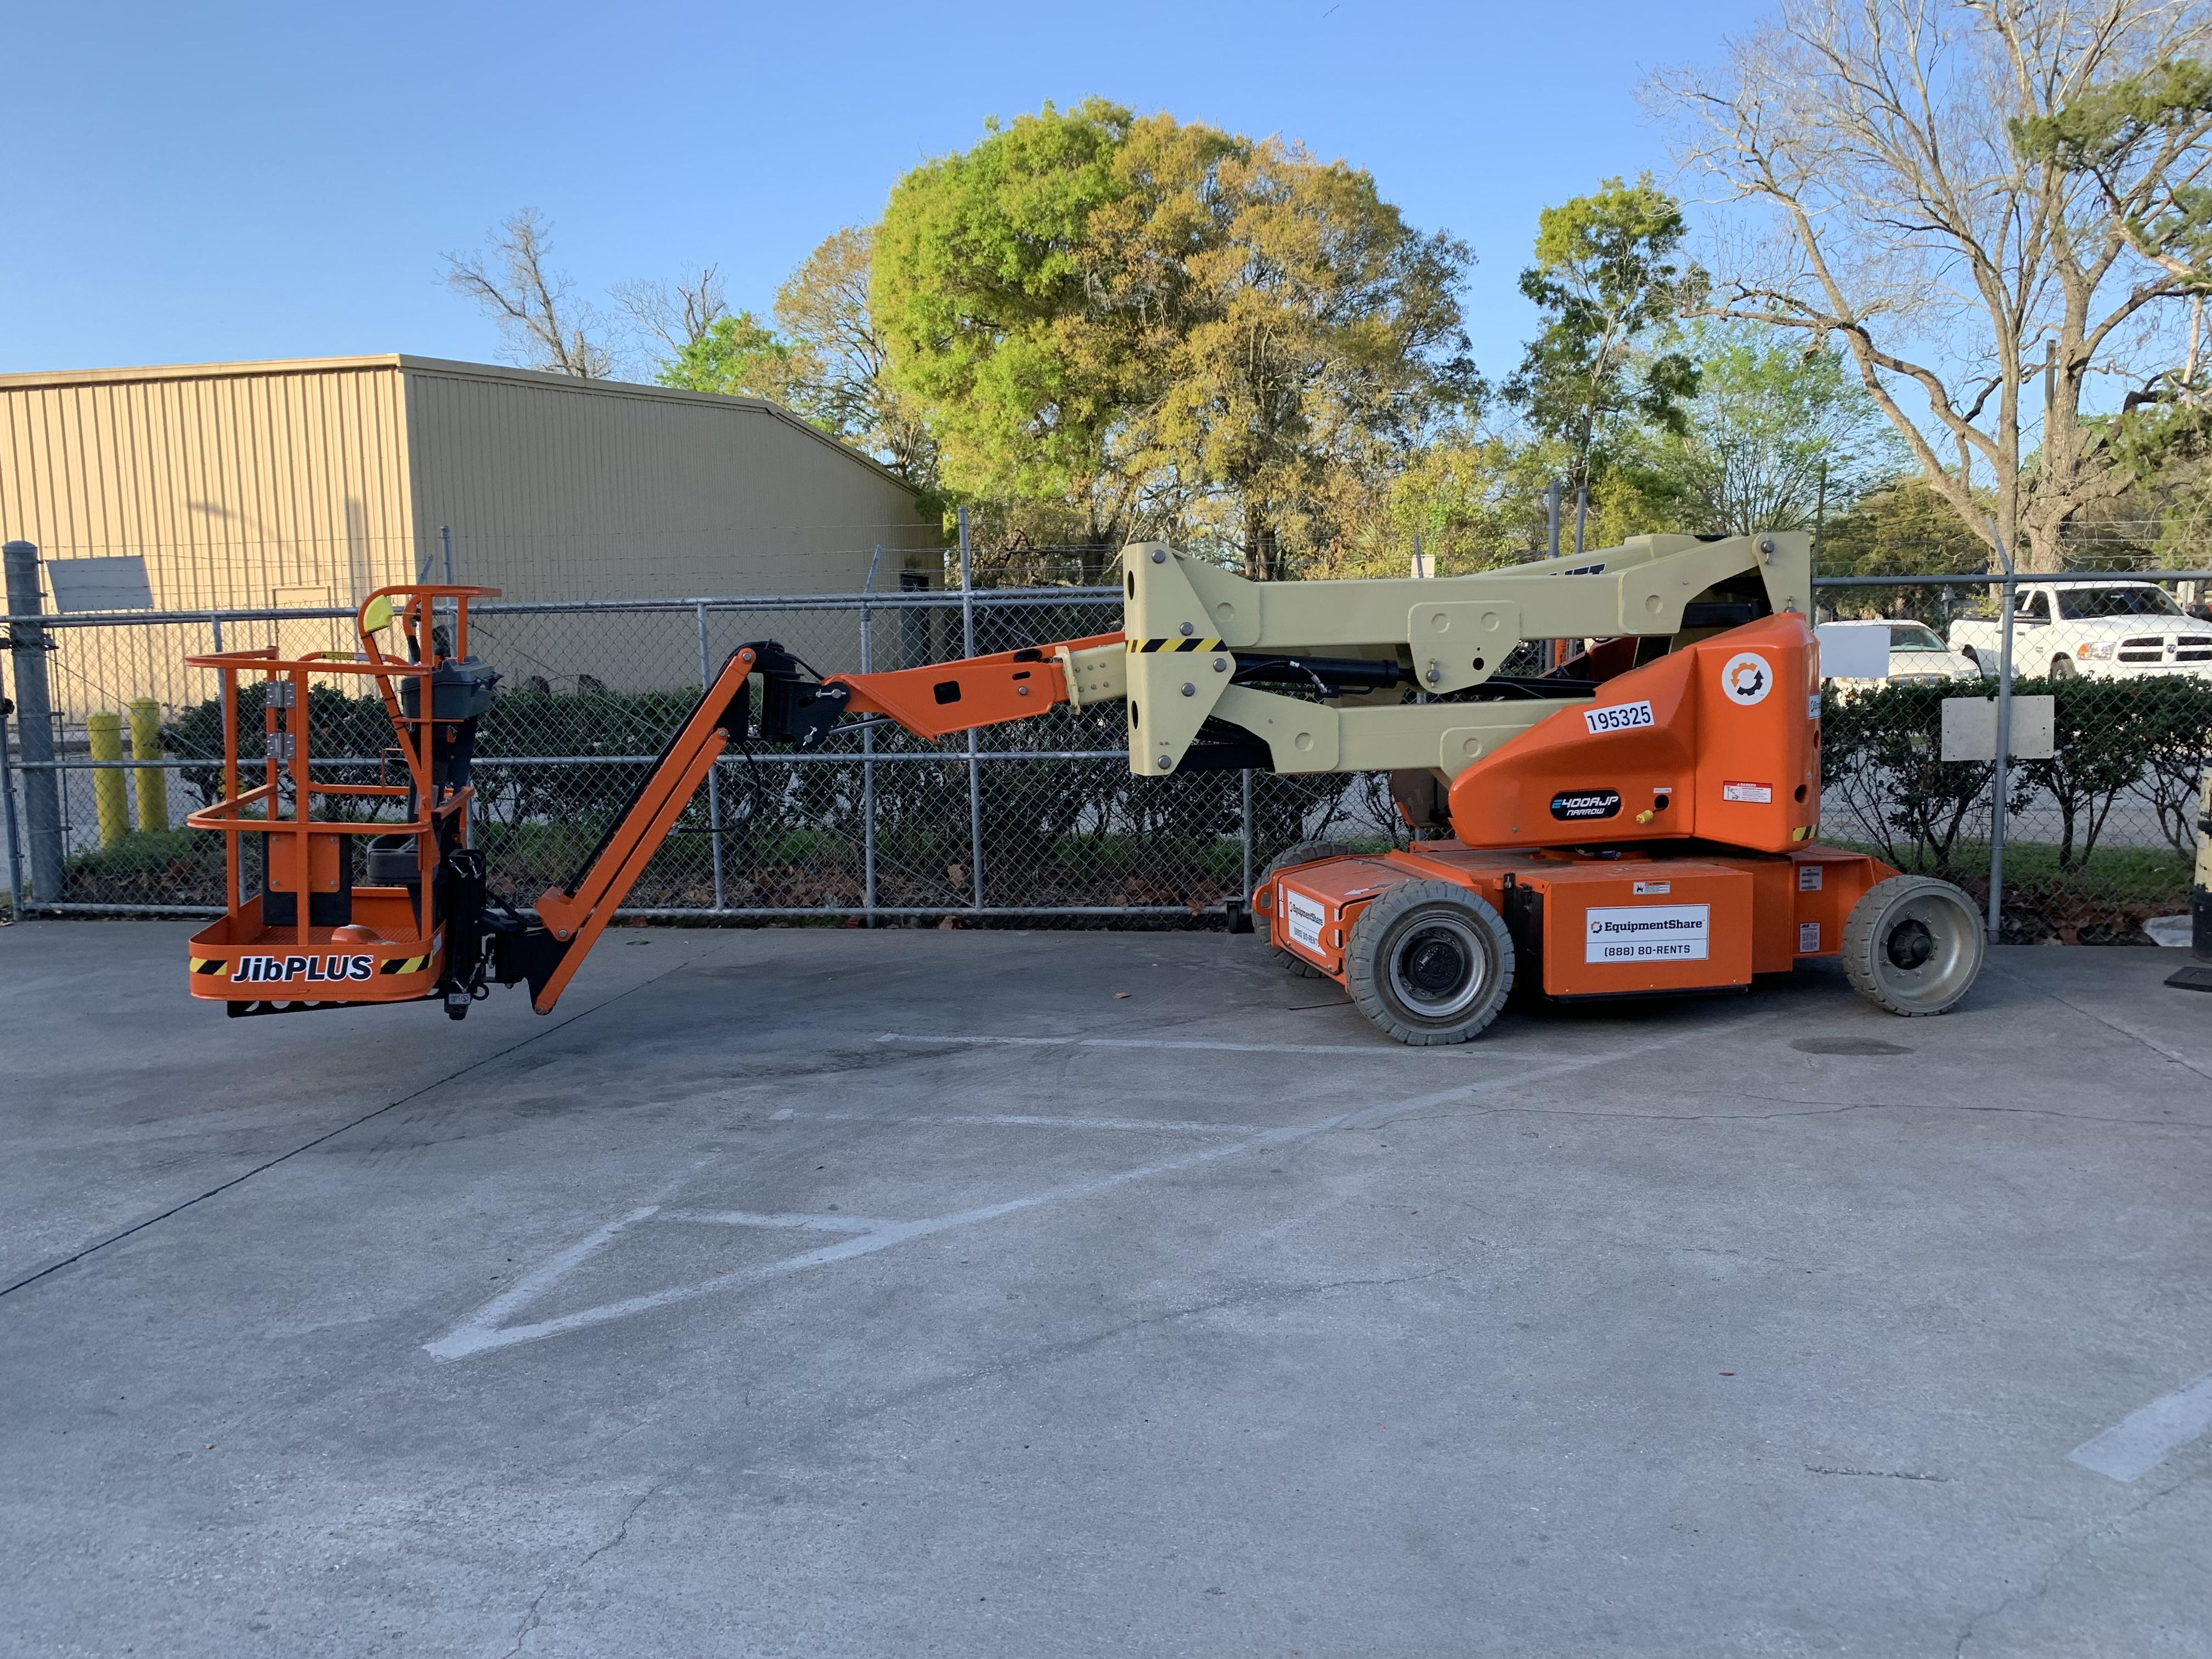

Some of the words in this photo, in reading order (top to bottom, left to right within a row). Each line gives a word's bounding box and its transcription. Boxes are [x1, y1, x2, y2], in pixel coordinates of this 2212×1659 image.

[1587, 706, 1651, 731] 195325
[1551, 796, 1619, 809] E400AJP
[1566, 808, 1605, 816] NARROW
[1604, 919, 1703, 933] EquipmentShare
[1604, 946, 1634, 957] (888)
[1638, 945, 1691, 955] 80-RENTS
[232, 955, 374, 982] JibPLUS
